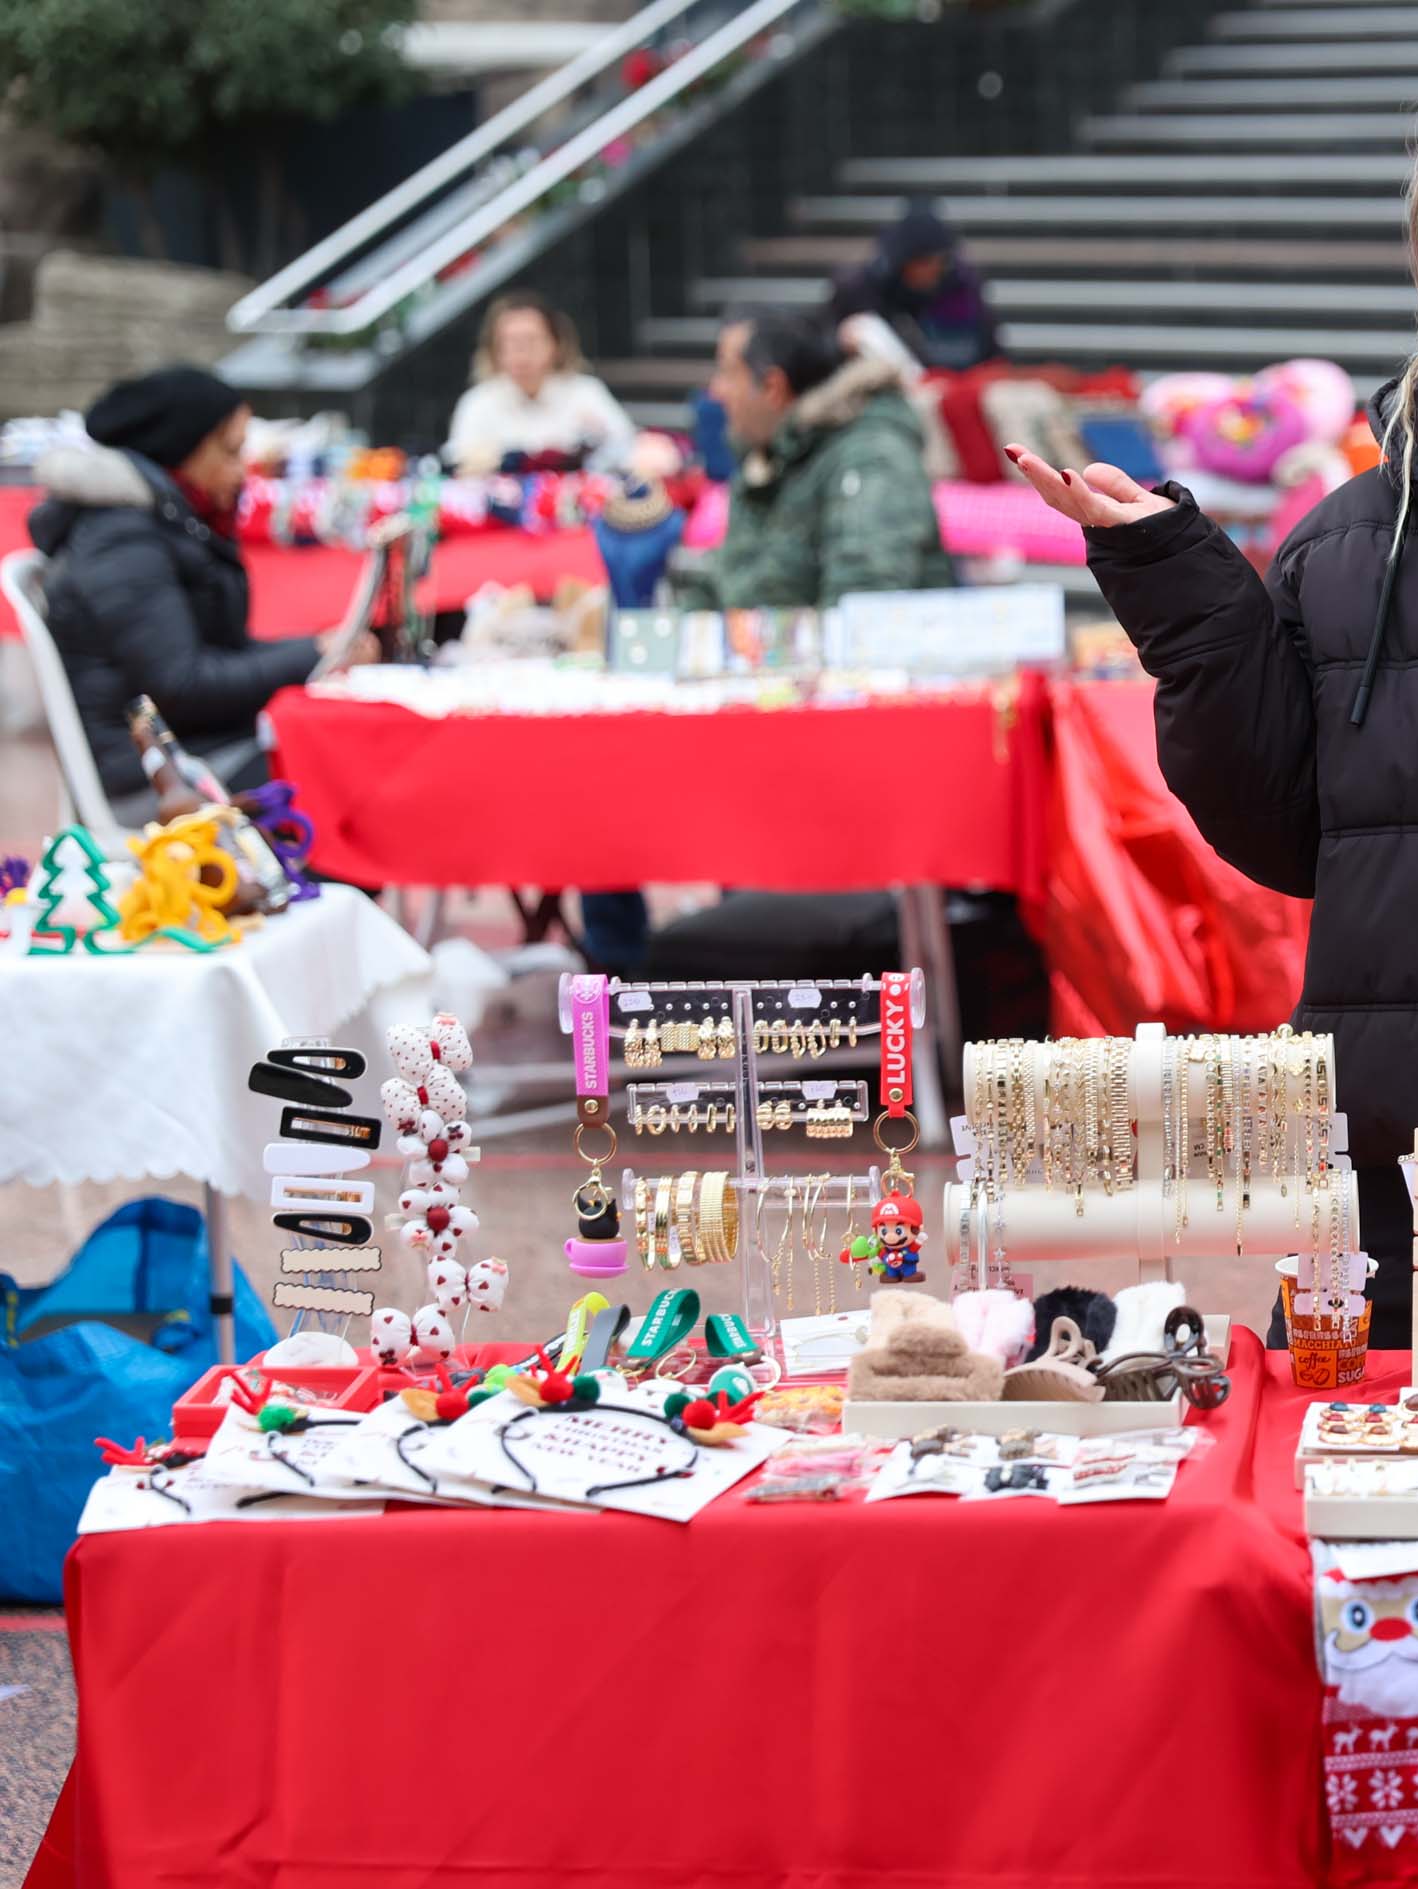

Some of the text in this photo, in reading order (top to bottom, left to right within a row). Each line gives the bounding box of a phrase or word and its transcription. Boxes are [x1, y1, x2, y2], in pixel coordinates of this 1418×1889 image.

[582, 1011, 598, 1090] STARBUCKS
[885, 999, 906, 1085] LUCKY
[641, 1288, 682, 1347] STARBUC
[1298, 1352, 1332, 1370] coffee
